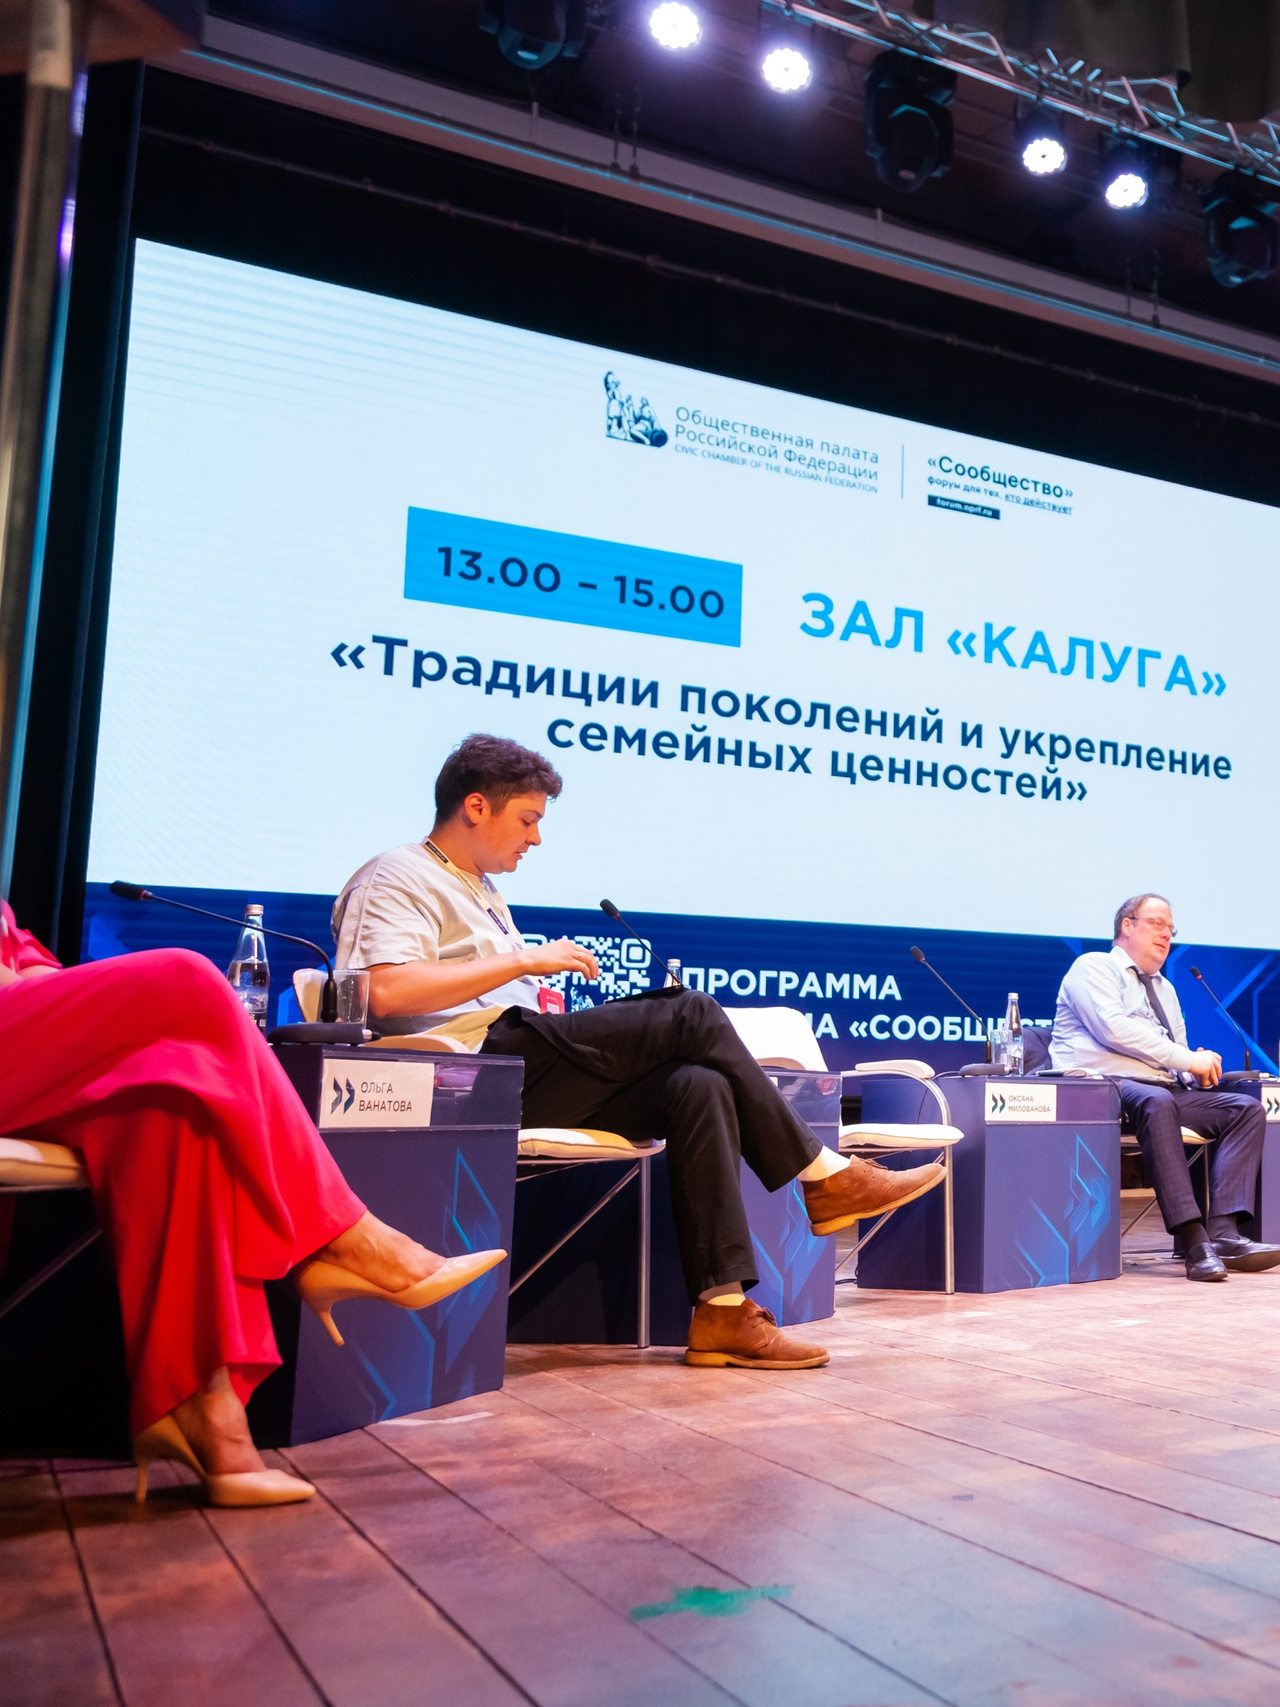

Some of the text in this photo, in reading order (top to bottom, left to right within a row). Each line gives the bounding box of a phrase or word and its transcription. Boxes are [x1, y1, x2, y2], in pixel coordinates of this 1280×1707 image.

[675, 424, 879, 480] Российской Федерации
[676, 406, 879, 464] Общественная палата
[674, 443, 879, 494] CIVIC CHAMBER OF THE RUSSIAN FEDERATION
[928, 456, 1074, 498] «Сообщество»
[928, 476, 961, 489] форум
[963, 483, 982, 494] для
[1005, 493, 1022, 503] кто
[1022, 497, 1073, 514] действует
[437, 546, 561, 593] 13.00
[614, 575, 725, 618] 15.00
[799, 592, 1227, 697] ЗАЛ «КАЛУГА»
[330, 634, 1233, 780] «Традиции поколений и укрепление
[547, 717, 1088, 801] семейных ценностей»
[682, 967, 902, 1001] ПРОГРАММА
[358, 1099, 413, 1112] ВАНАТОВА
[360, 1081, 394, 1094] ОЛЬГА
[1008, 1105, 1051, 1113] МИЛОВАНОВА
